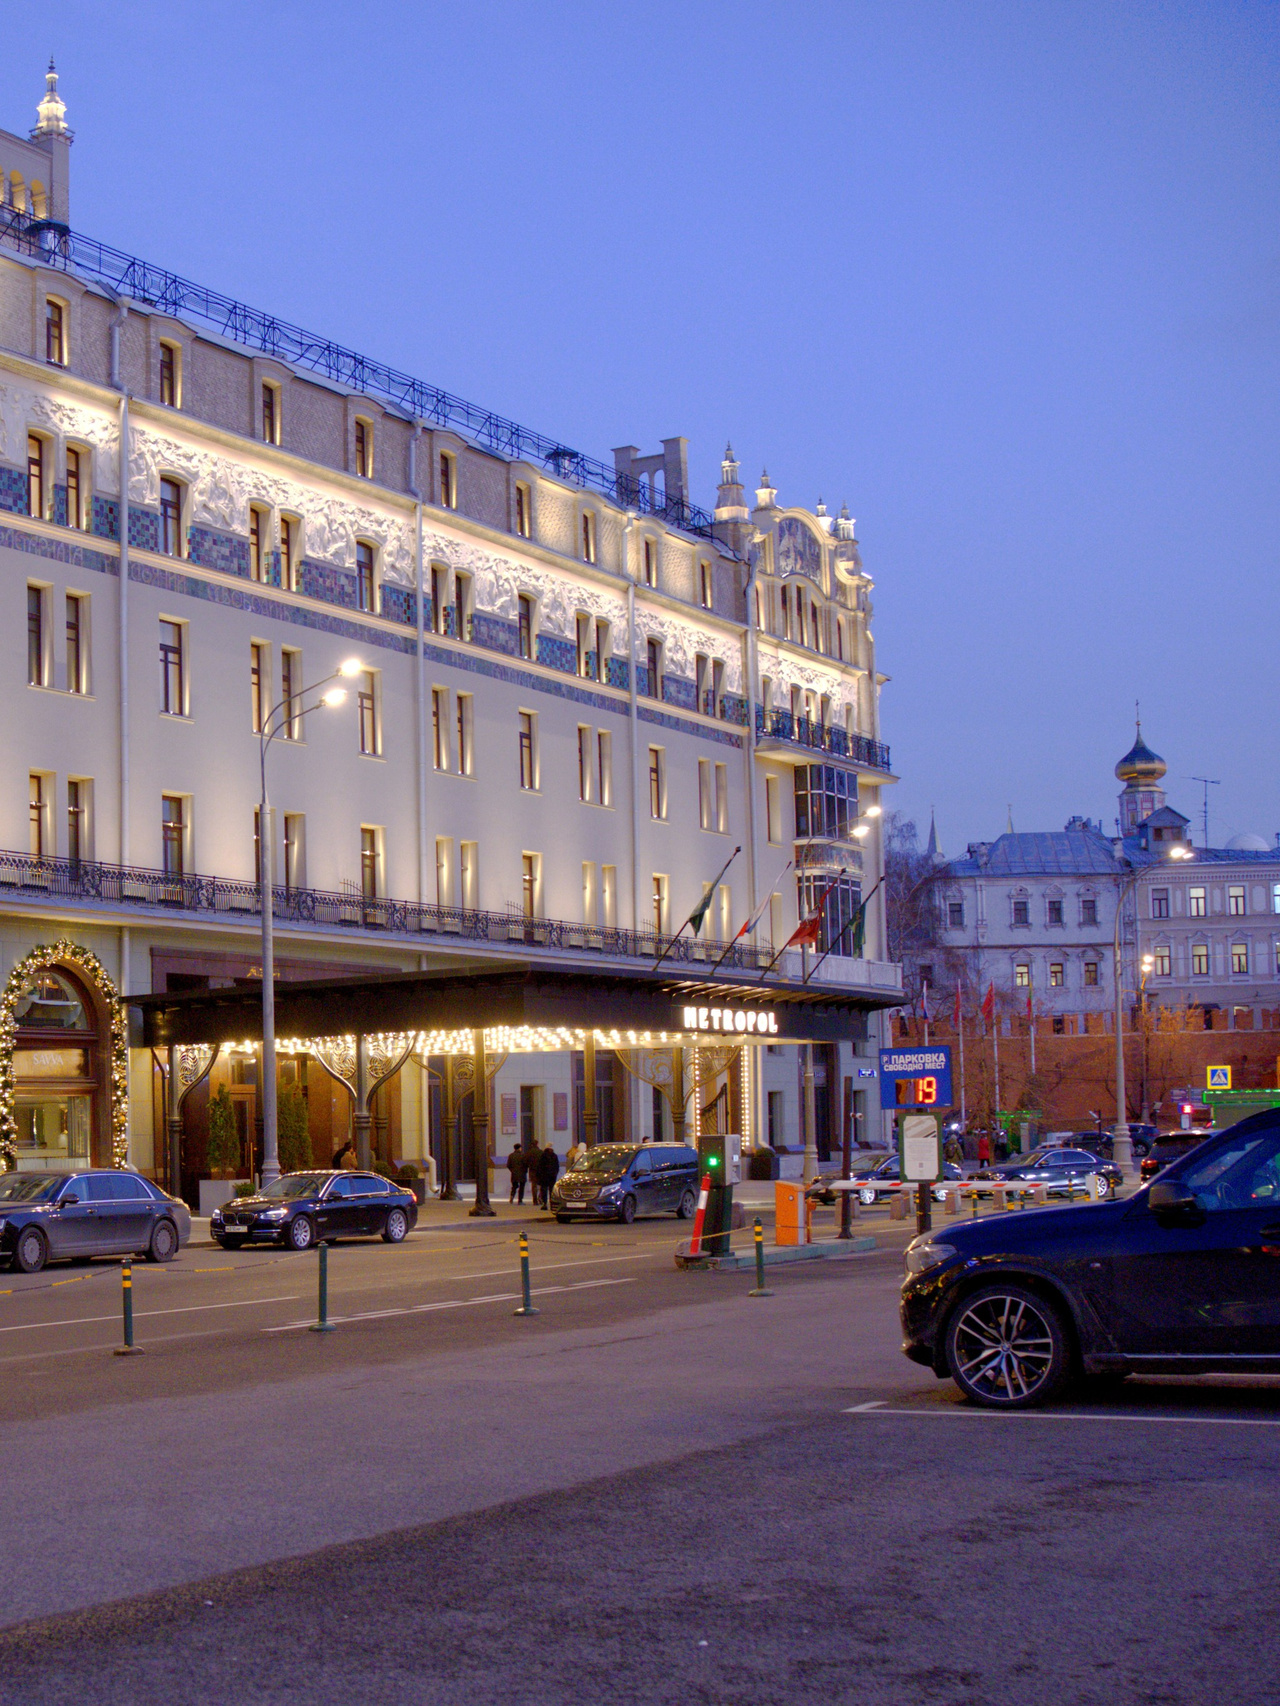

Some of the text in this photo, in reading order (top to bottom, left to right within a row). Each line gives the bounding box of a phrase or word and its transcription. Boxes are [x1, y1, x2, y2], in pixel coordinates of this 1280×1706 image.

[683, 1006, 779, 1033] METROPOL
[883, 1062, 945, 1072] СВОБОДНО МЕСТ
[891, 1052, 946, 1065] ПАРКОВКА
[919, 1076, 936, 1104] 19
